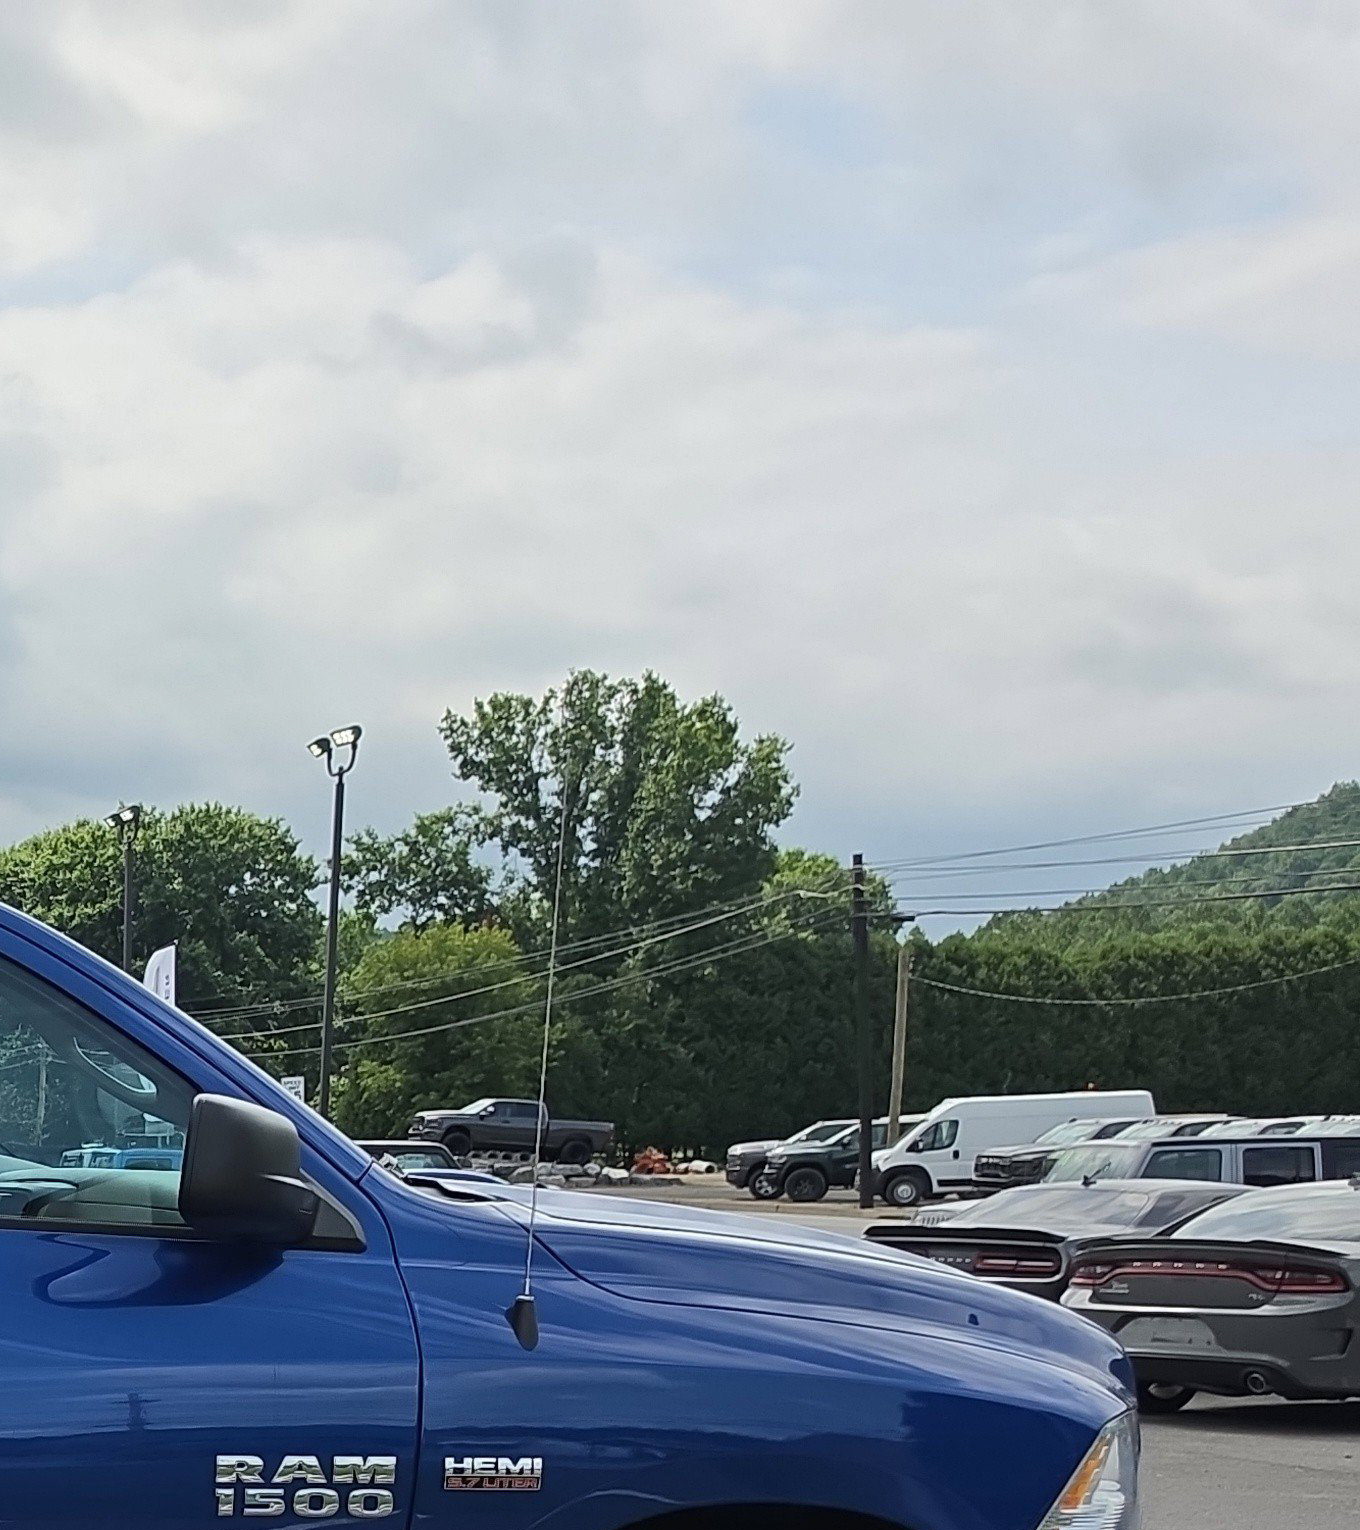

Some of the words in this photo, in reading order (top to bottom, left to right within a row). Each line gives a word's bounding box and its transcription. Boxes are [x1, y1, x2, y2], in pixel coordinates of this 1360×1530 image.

[215, 1454, 398, 1484] RAM
[444, 1457, 543, 1475] HEMI
[447, 1477, 480, 1488] 5.7
[483, 1477, 538, 1488] LITER
[215, 1488, 395, 1518] 1500
